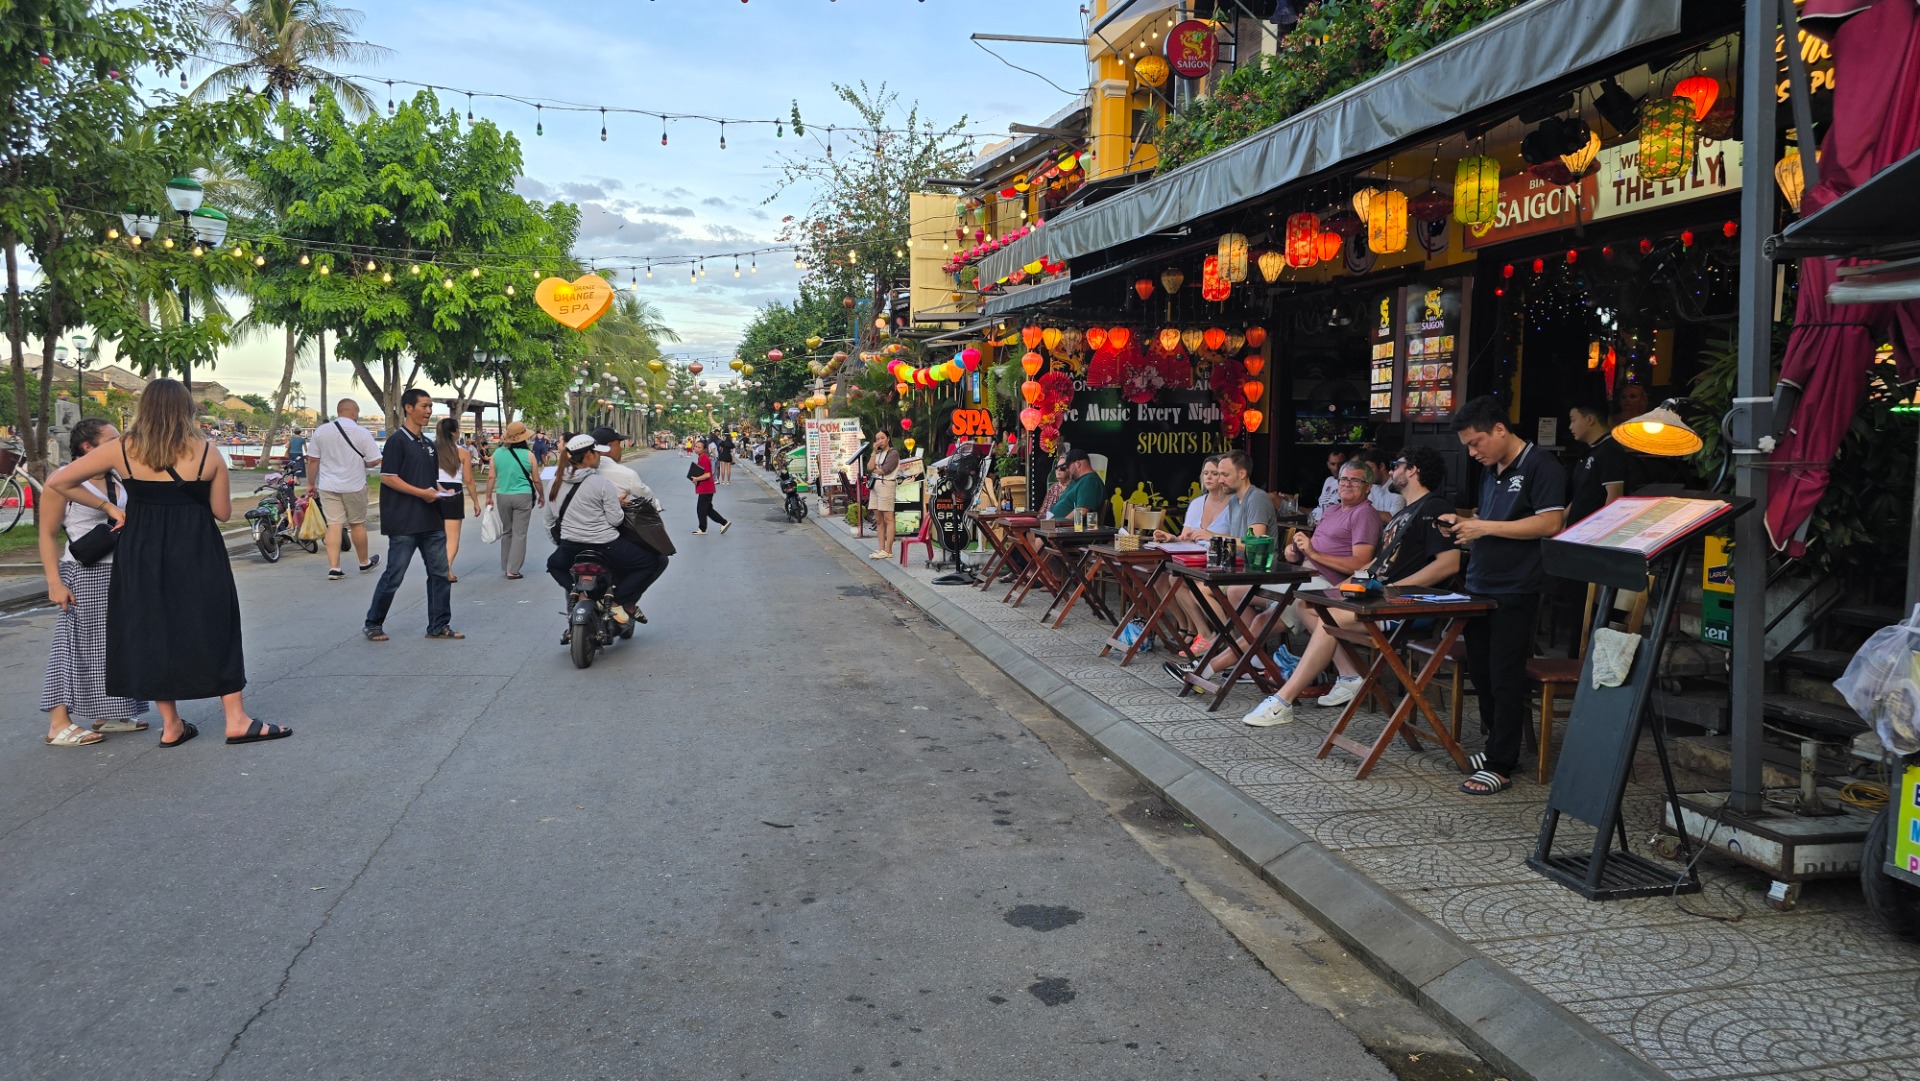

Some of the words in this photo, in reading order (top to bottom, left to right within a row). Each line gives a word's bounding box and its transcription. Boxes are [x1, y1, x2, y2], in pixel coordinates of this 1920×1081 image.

[1177, 60, 1209, 68] SAIGON
[1529, 178, 1545, 190] BIA
[1612, 175, 1656, 206] THE
[1494, 182, 1582, 229] SAIGON
[553, 292, 595, 302] ORANGE
[559, 303, 590, 315] SPA
[1421, 320, 1445, 331] SAIGON
[1086, 403, 1131, 422] Music
[1137, 403, 1182, 425] Every
[1188, 402, 1224, 425] Nigh
[951, 408, 995, 436] SPA
[1137, 431, 1198, 454] SPORTS
[1709, 570, 1728, 579] LARUE
